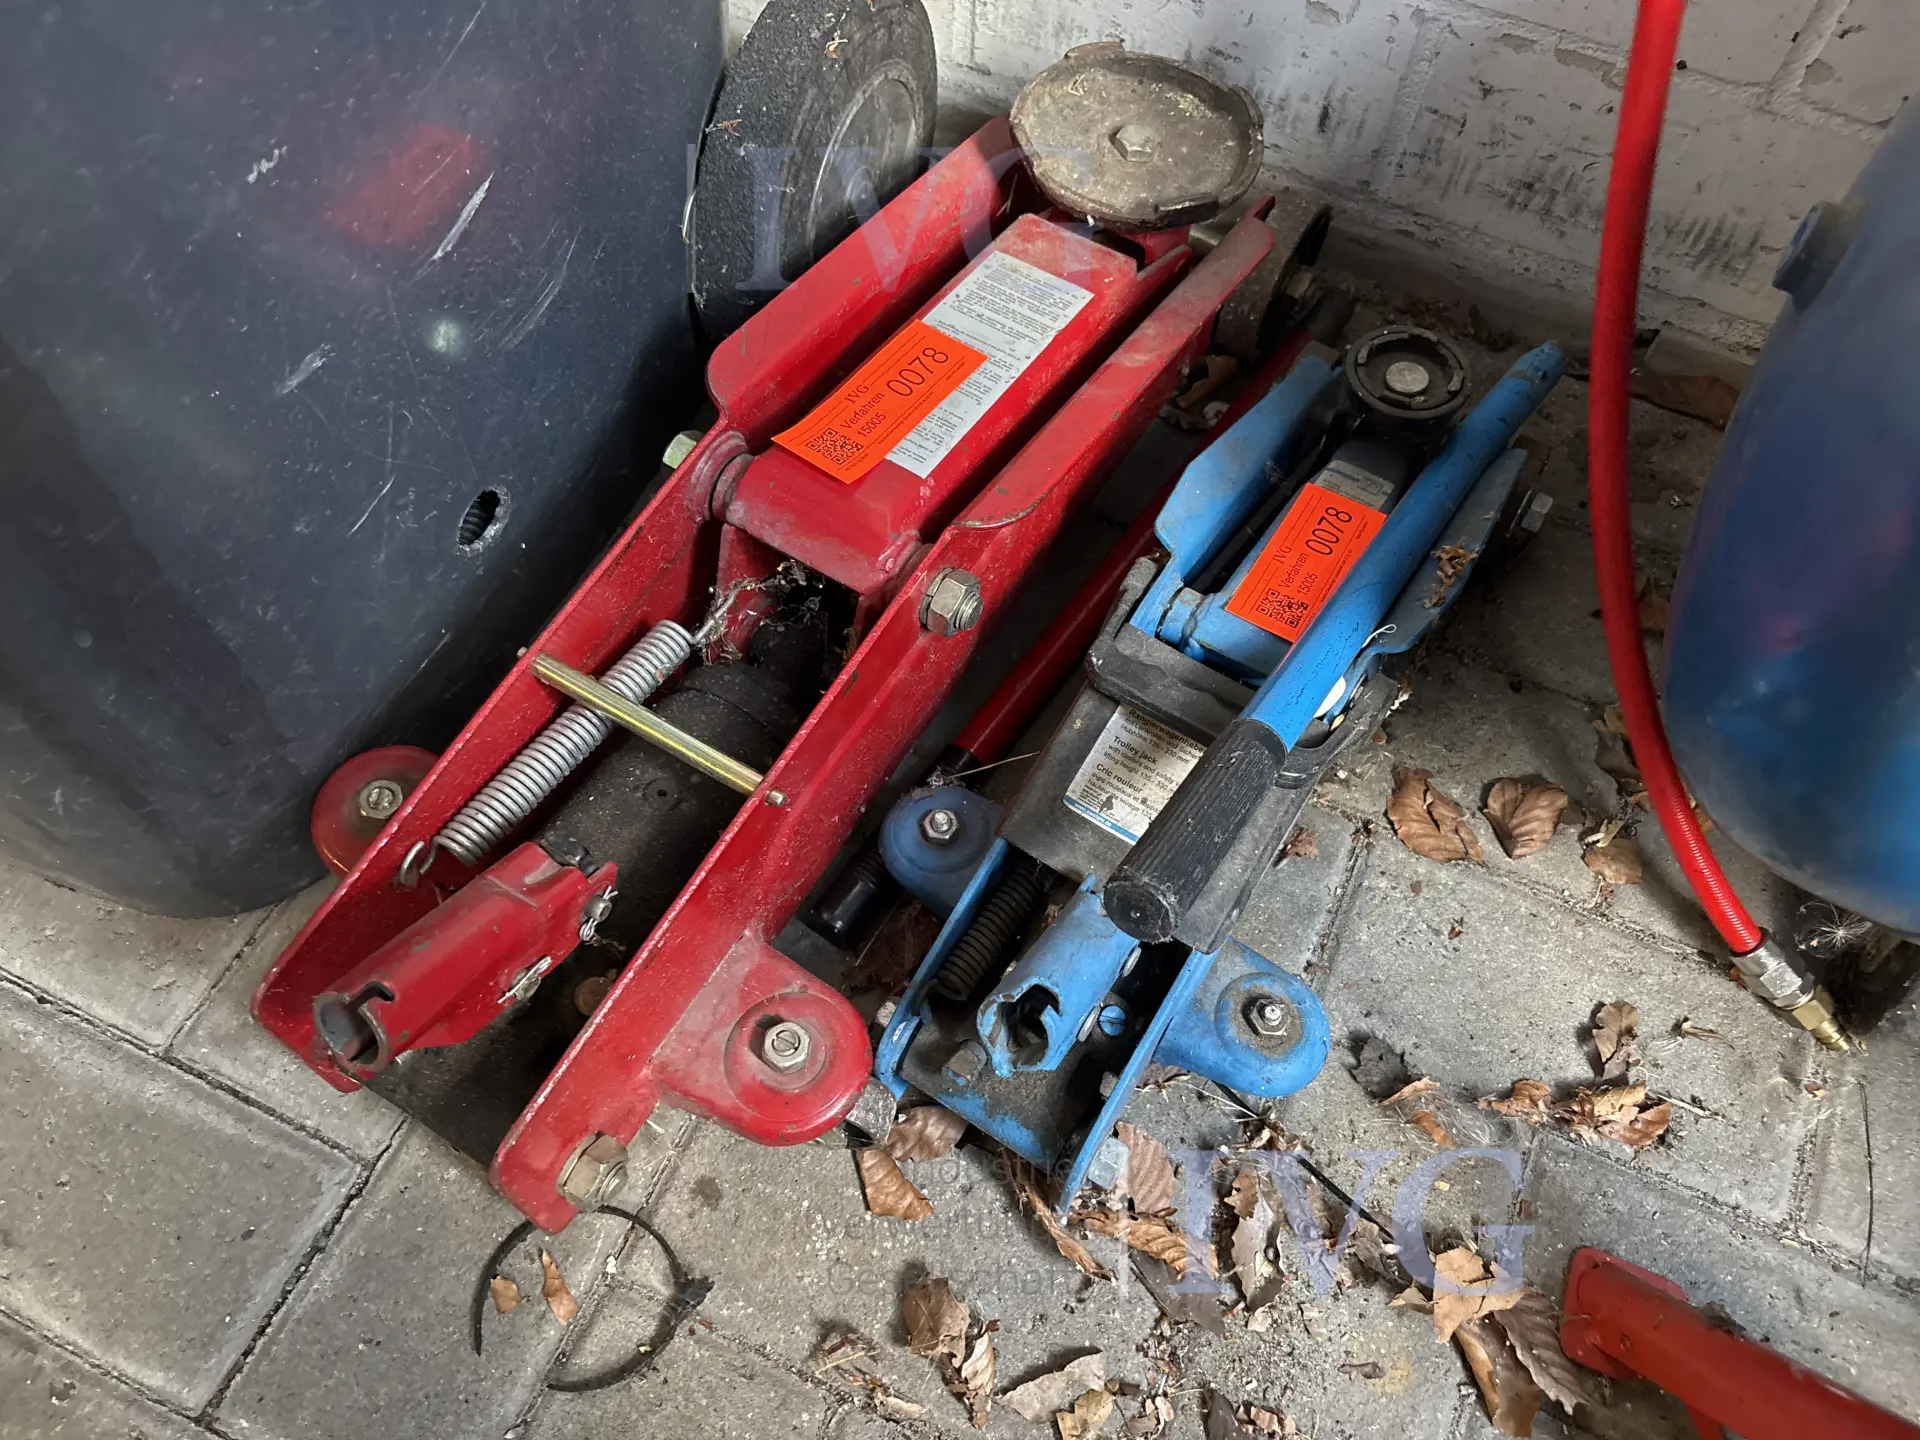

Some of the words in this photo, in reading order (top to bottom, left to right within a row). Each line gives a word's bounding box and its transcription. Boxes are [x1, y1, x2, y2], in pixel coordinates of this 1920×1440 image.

[887, 347, 950, 396] 0078
[845, 384, 872, 405] IVG
[840, 392, 885, 430] Verfahren
[857, 412, 887, 438] 15005
[1306, 506, 1352, 556] 0078
[1272, 544, 1292, 564] IVG
[1279, 553, 1308, 588] Verfahren
[1297, 573, 1318, 596] 15005
[1129, 709, 1204, 753] Rangierwagenhebe
[1108, 744, 1120, 755] with
[1143, 762, 1156, 773] and
[1156, 770, 1175, 785] safety
[1114, 736, 1139, 755] Trolley
[1139, 750, 1158, 765] jack
[1148, 739, 1160, 750] 135
[1164, 748, 1176, 758] 330
[1176, 756, 1189, 764] mm
[1096, 763, 1112, 777] Cric
[1113, 773, 1143, 793] rouleur
[1103, 751, 1119, 765] lifting
[1119, 759, 1139, 775] height
[1140, 771, 1152, 783] 135
[1156, 780, 1167, 790] 330
[1087, 778, 1111, 795] hauteur
